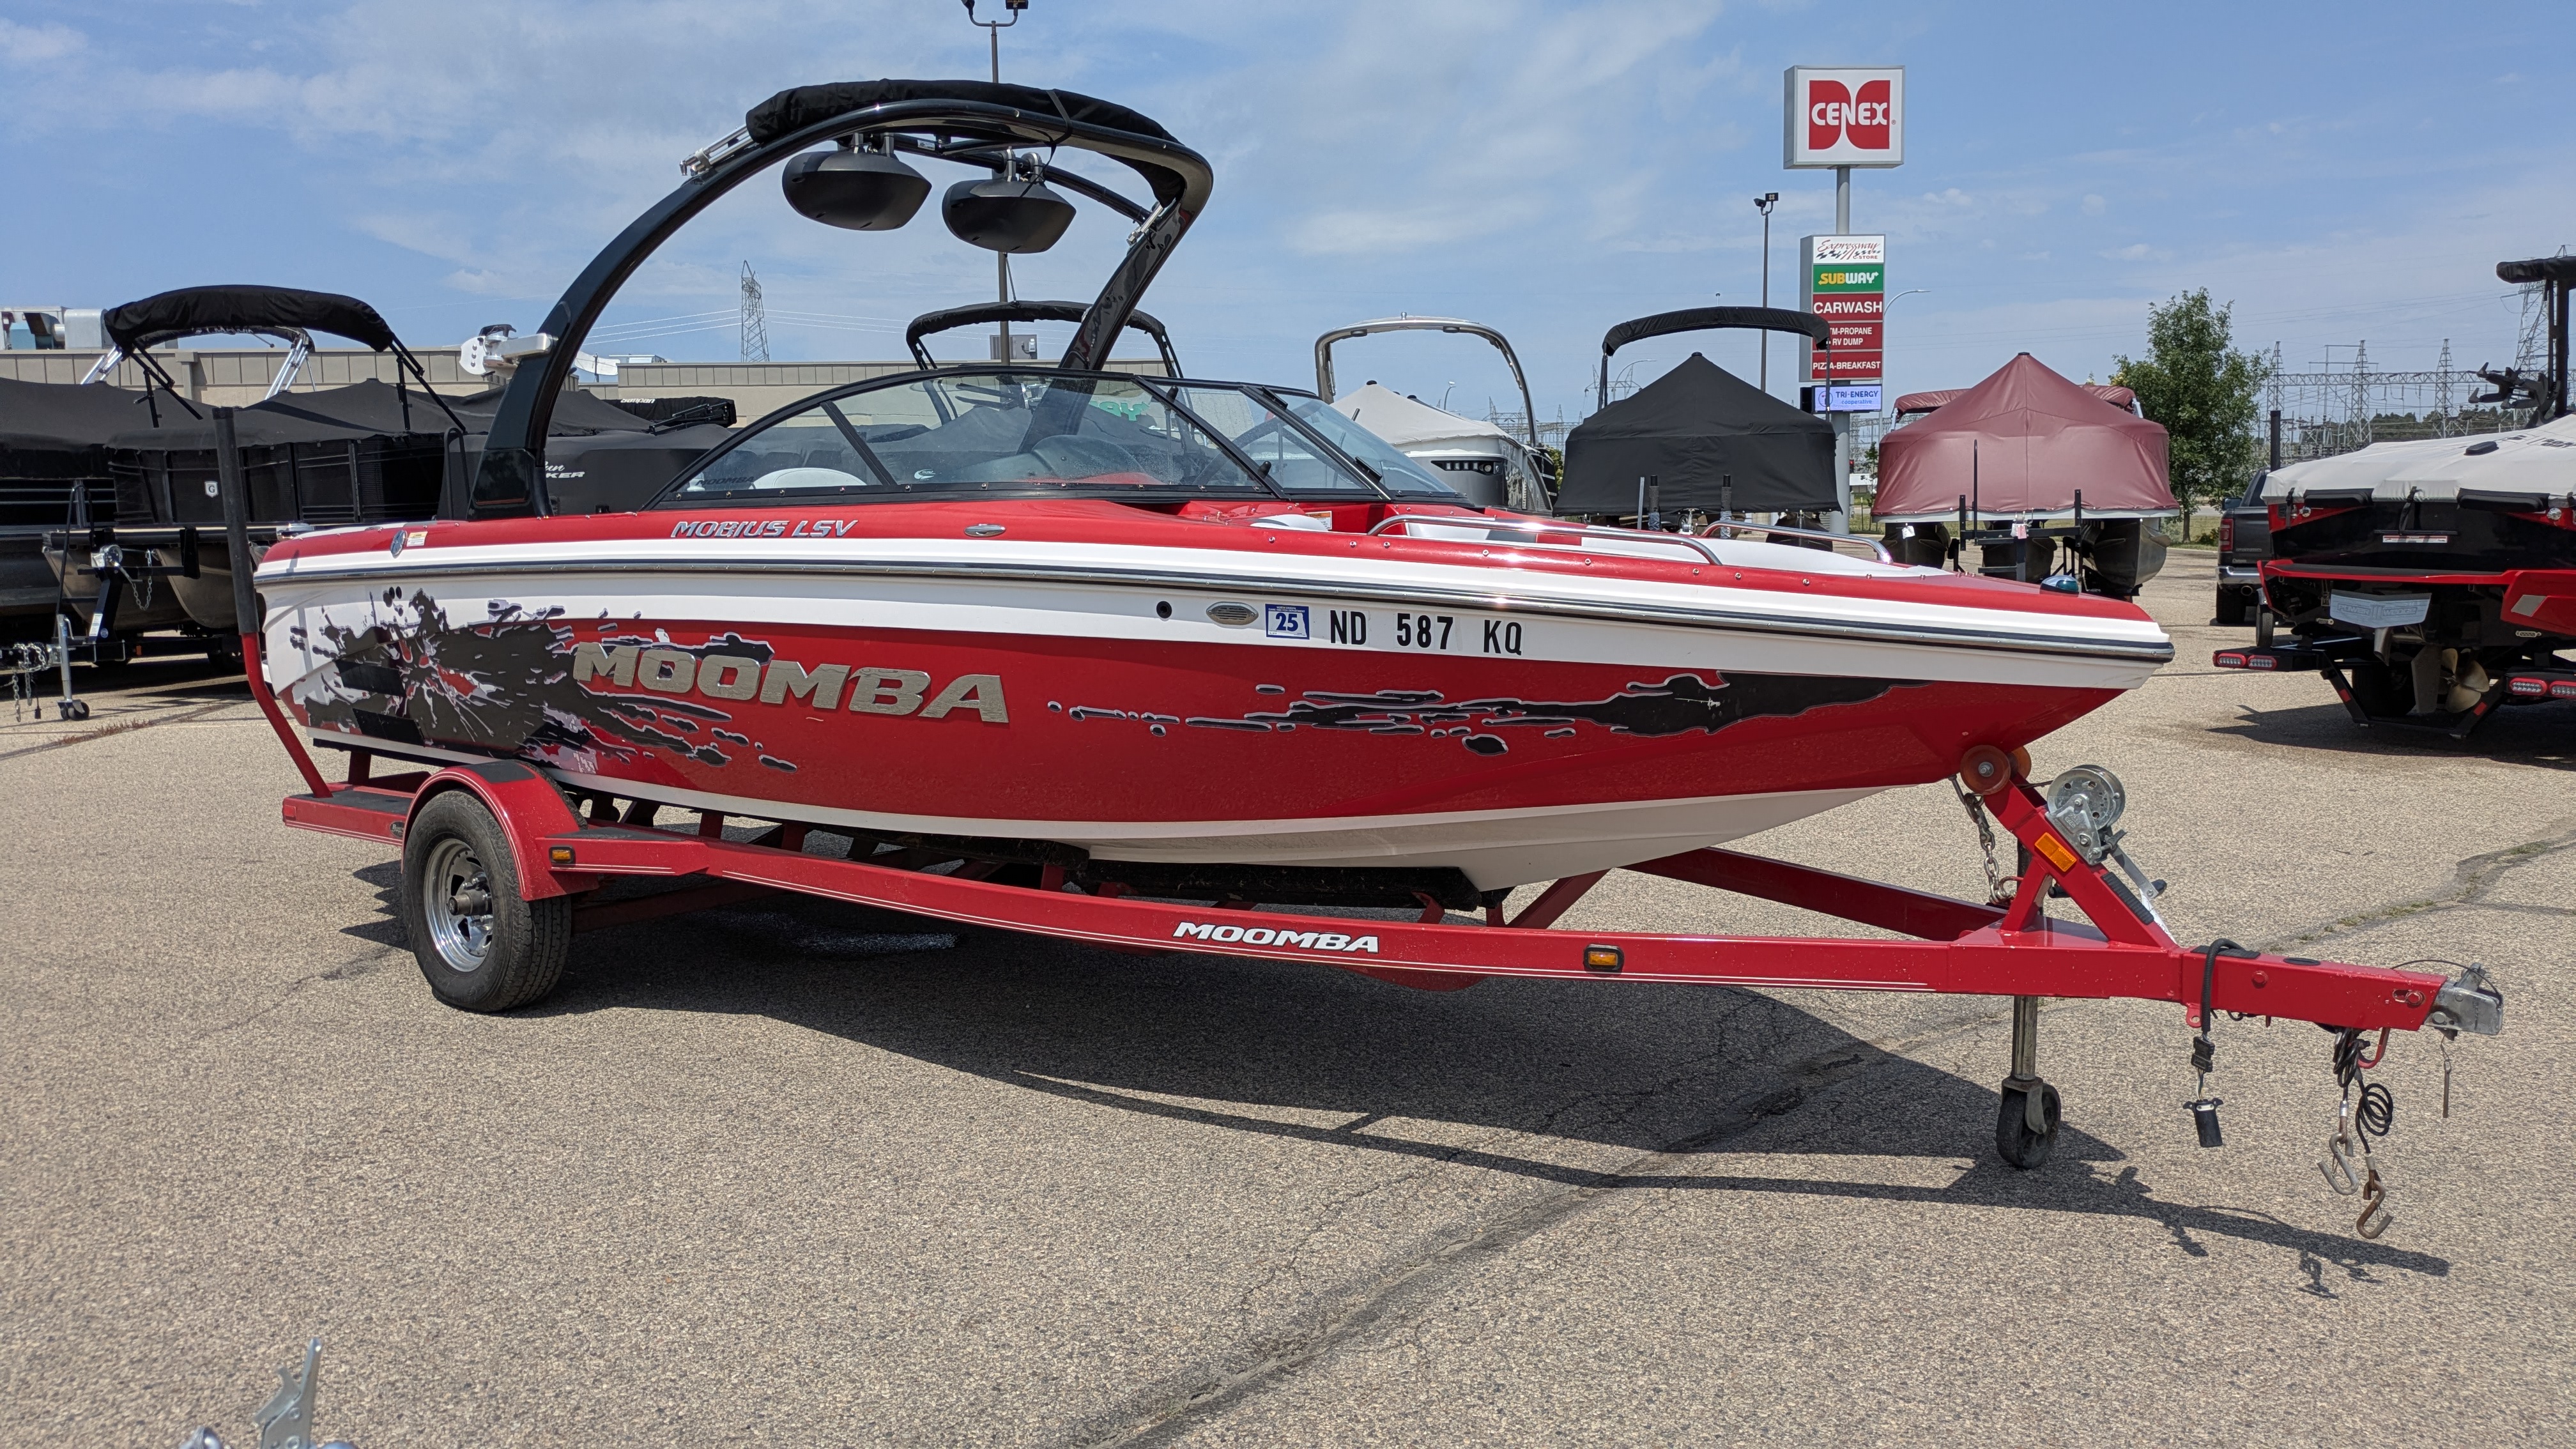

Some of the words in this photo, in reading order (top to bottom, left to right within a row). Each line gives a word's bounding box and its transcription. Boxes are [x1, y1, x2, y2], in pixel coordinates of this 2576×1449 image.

[1811, 102, 1887, 125] CENEX
[1817, 239, 1880, 256] Expressway
[1818, 272, 1879, 285] SUBWAY
[1813, 301, 1882, 314] CARWASH
[208, 485, 215, 493] G
[694, 476, 755, 486] MOOMBA
[671, 521, 790, 538] MOBIUS
[791, 520, 859, 538] LSV
[1275, 612, 1299, 632] 25
[1330, 610, 1367, 645] ND
[1397, 613, 1453, 650] 587
[1483, 619, 1522, 656] KQ
[573, 641, 1009, 723] MOOMBA
[1173, 922, 1378, 953] MOOMBA
